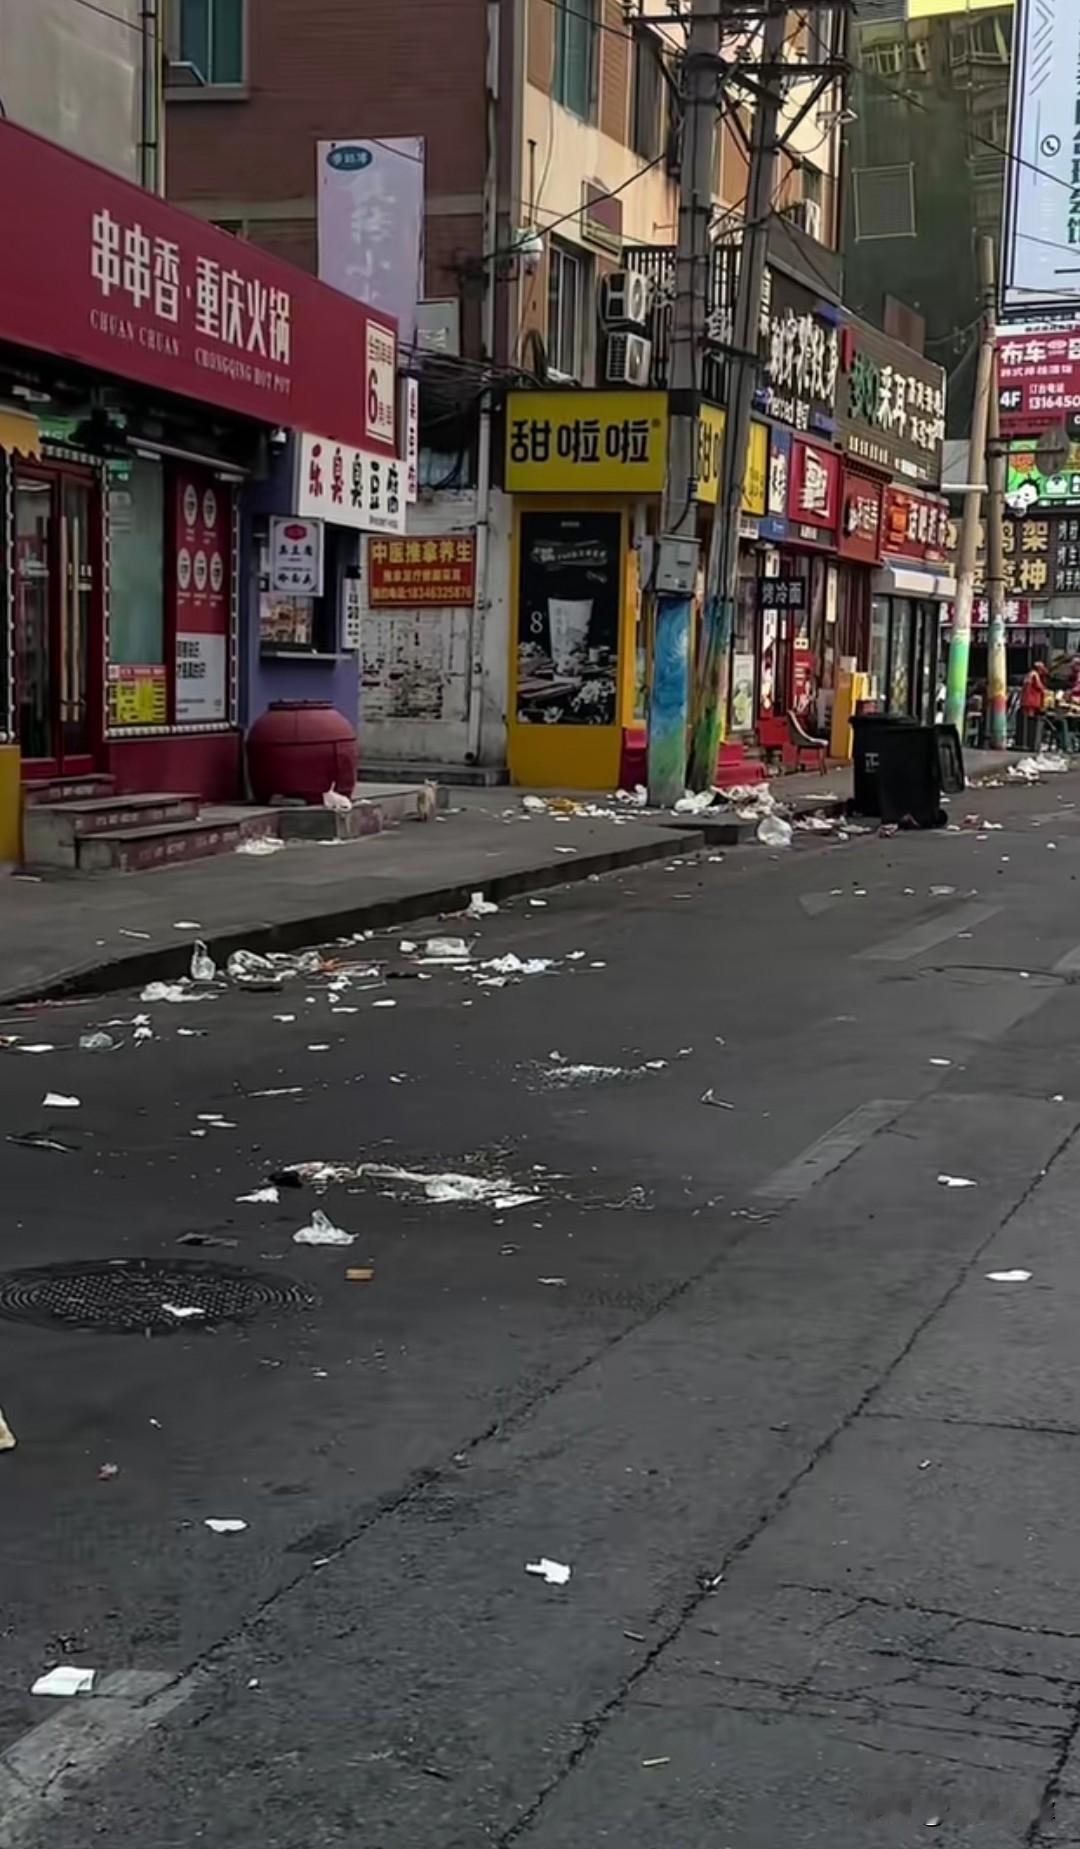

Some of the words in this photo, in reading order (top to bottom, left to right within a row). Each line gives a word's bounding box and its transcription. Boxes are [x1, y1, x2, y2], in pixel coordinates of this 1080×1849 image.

[90, 308, 134, 342] CHUAN
[138, 327, 180, 357] CHUAN
[194, 347, 252, 382] CHONGQING
[253, 365, 272, 388] HOT
[273, 375, 292, 396] POT
[1000, 391, 1022, 407] 4F
[511, 419, 649, 464] 甜啦啦
[530, 611, 543, 633] 8
